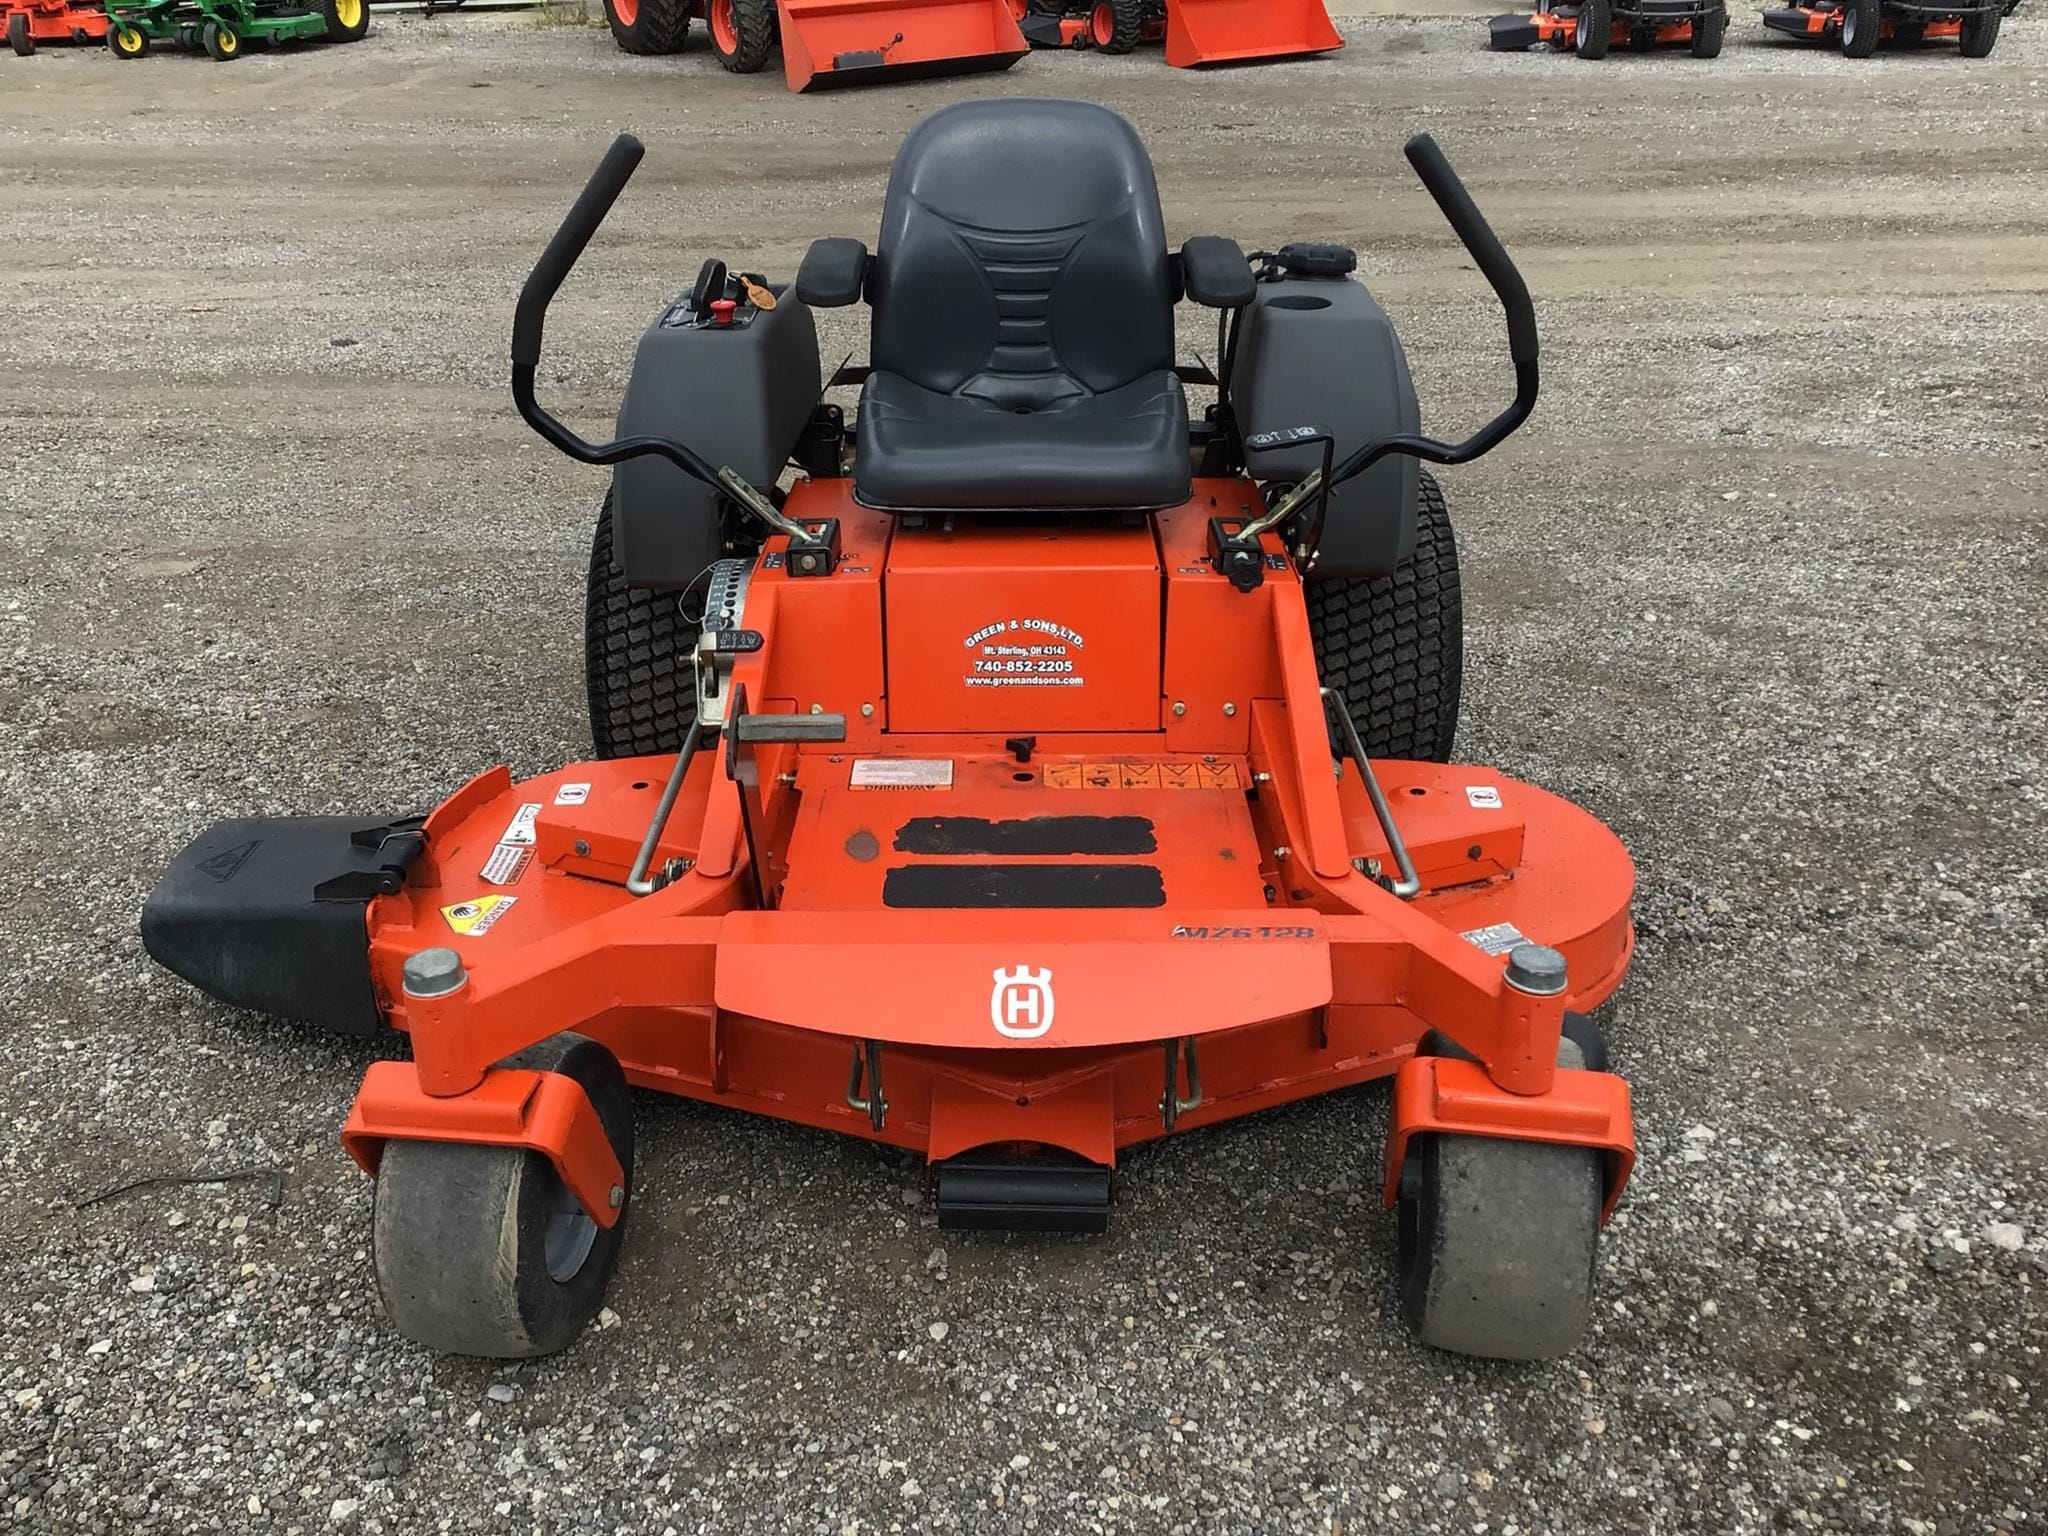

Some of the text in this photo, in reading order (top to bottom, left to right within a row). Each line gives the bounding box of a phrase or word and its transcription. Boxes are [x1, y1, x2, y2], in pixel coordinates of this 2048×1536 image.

[965, 622, 1006, 648] GREEN
[1010, 620, 1019, 630] &
[984, 646, 1066, 657] Mt. Sterling, OH 43143
[975, 661, 1073, 672] 740-852-2205
[966, 676, 1084, 687] www.greenandsons.com
